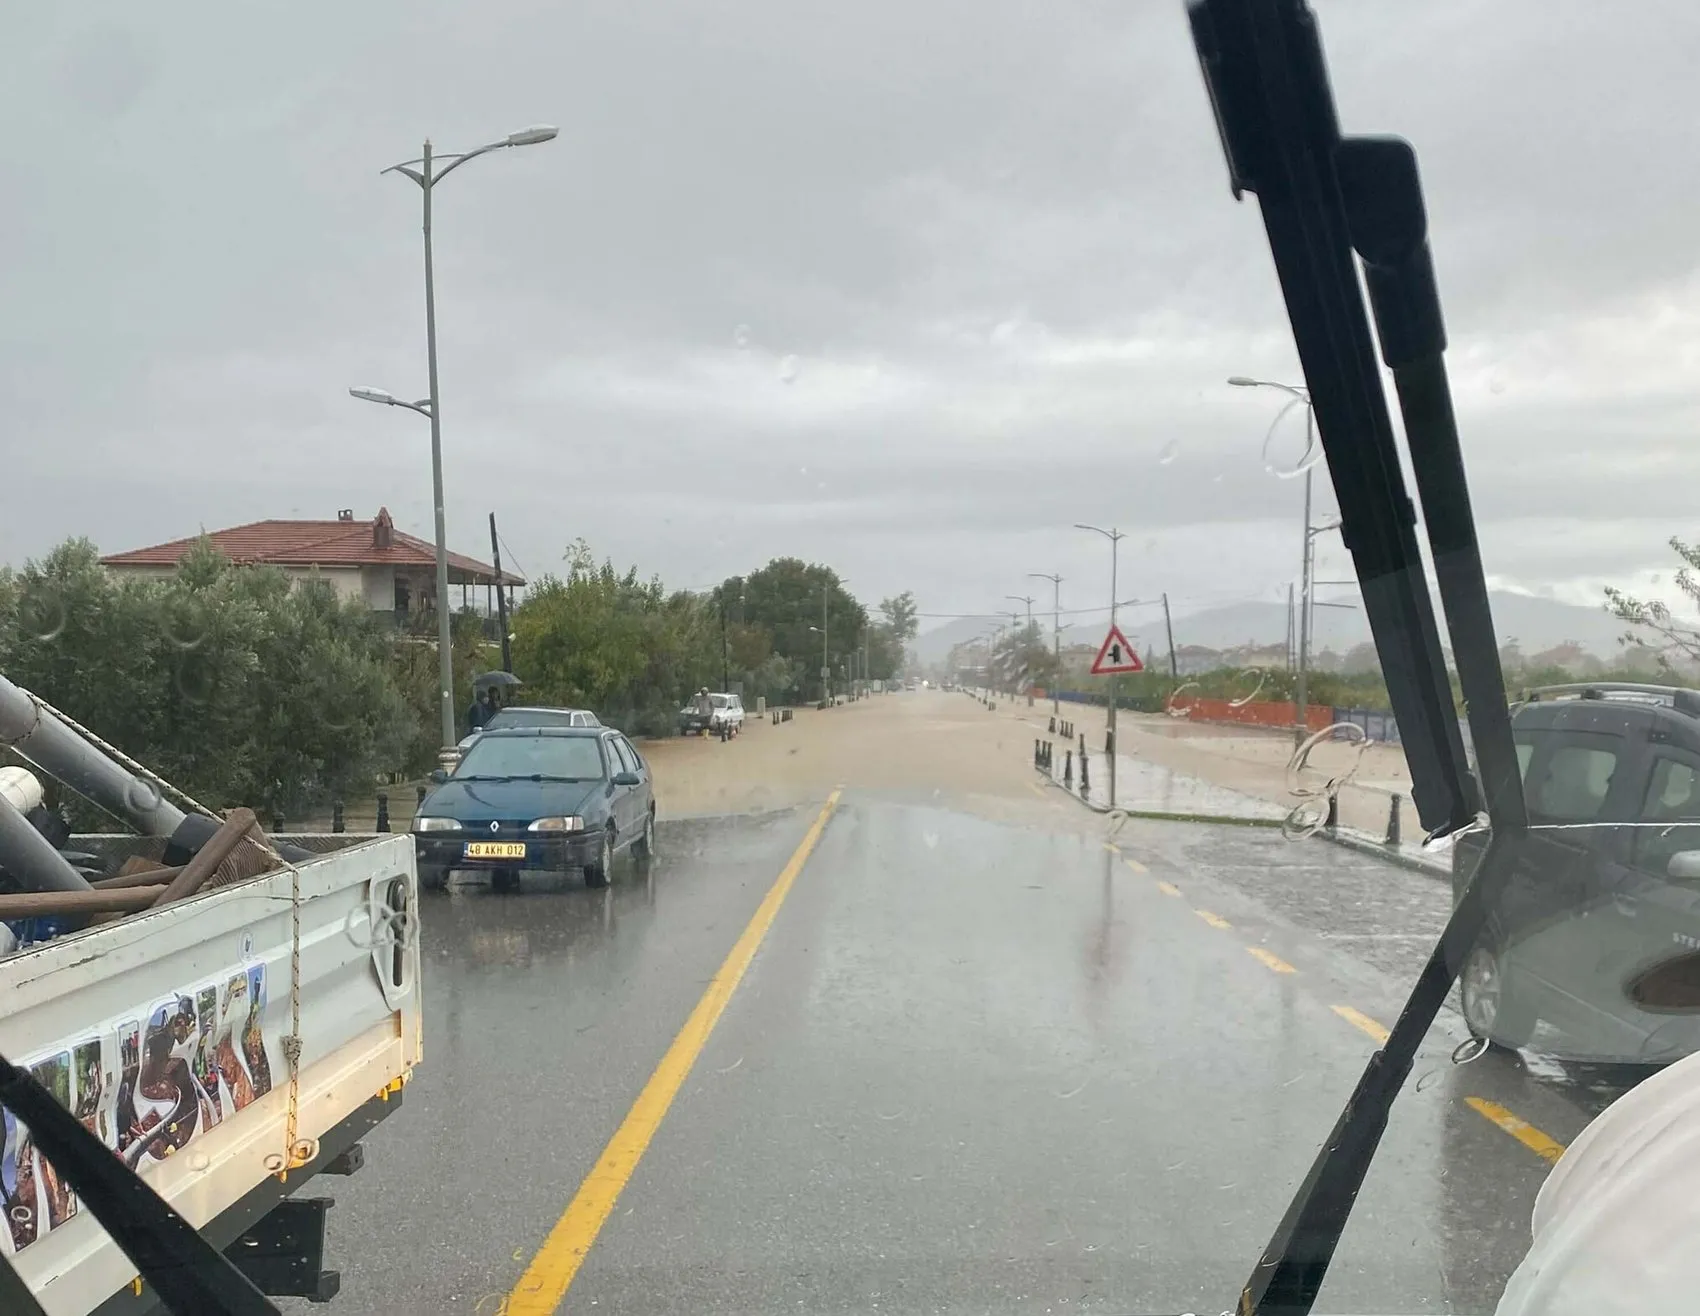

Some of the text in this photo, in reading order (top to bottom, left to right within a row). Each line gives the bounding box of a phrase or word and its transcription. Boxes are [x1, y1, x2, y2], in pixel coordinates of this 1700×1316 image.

[469, 844, 524, 856] 48 AKH 012
[1672, 931, 1700, 950] STE
